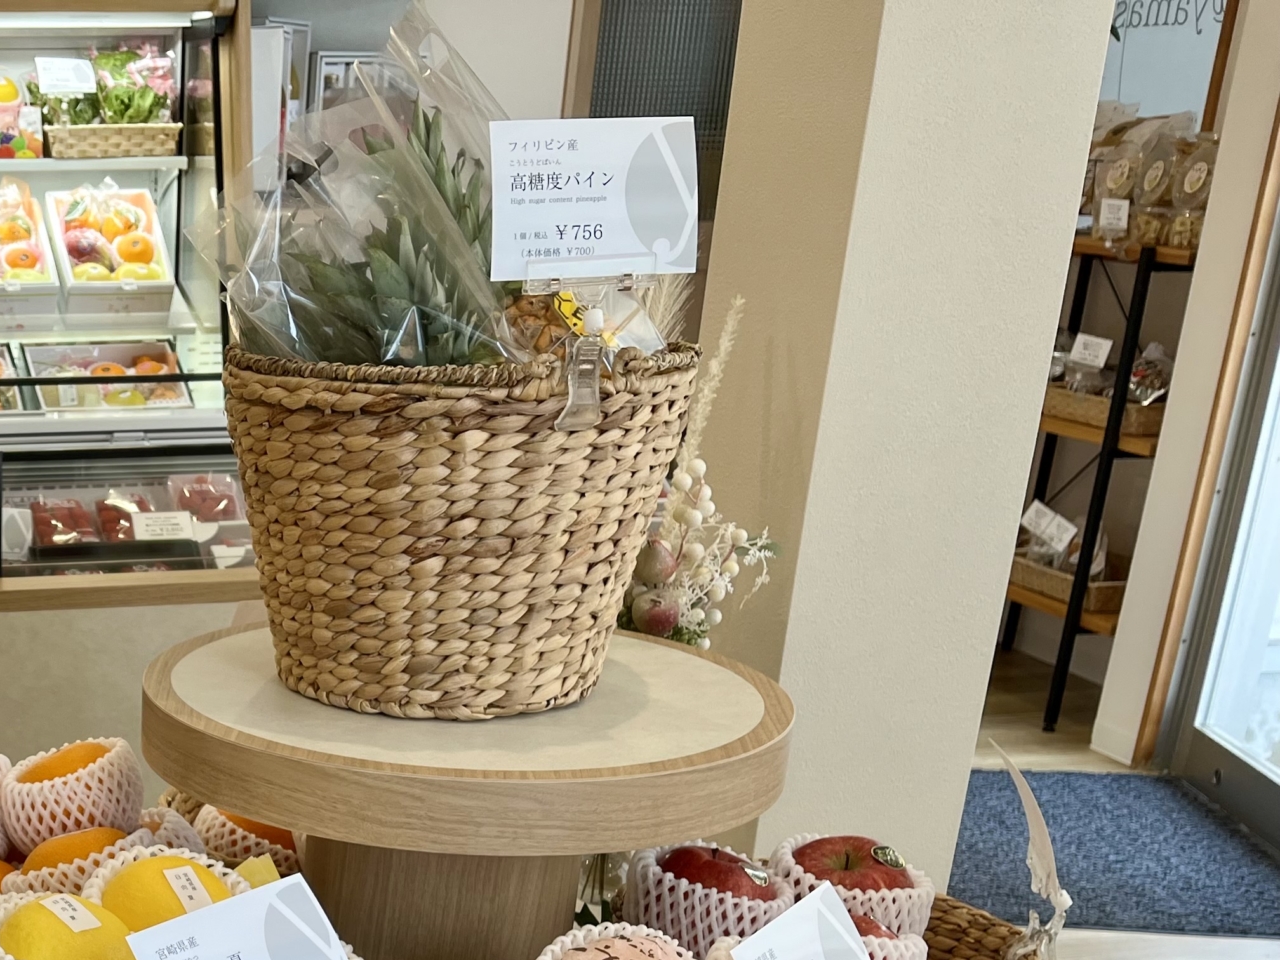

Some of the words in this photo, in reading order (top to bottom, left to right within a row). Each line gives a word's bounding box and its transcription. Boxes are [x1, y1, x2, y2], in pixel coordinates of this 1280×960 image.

[508, 139, 579, 152] フィリピン産
[510, 171, 615, 192] 高糖度パイン
[510, 197, 526, 205] High
[575, 195, 607, 204] pineapple
[555, 224, 603, 241] ¥756
[155, 935, 200, 960] 宮崎県産
